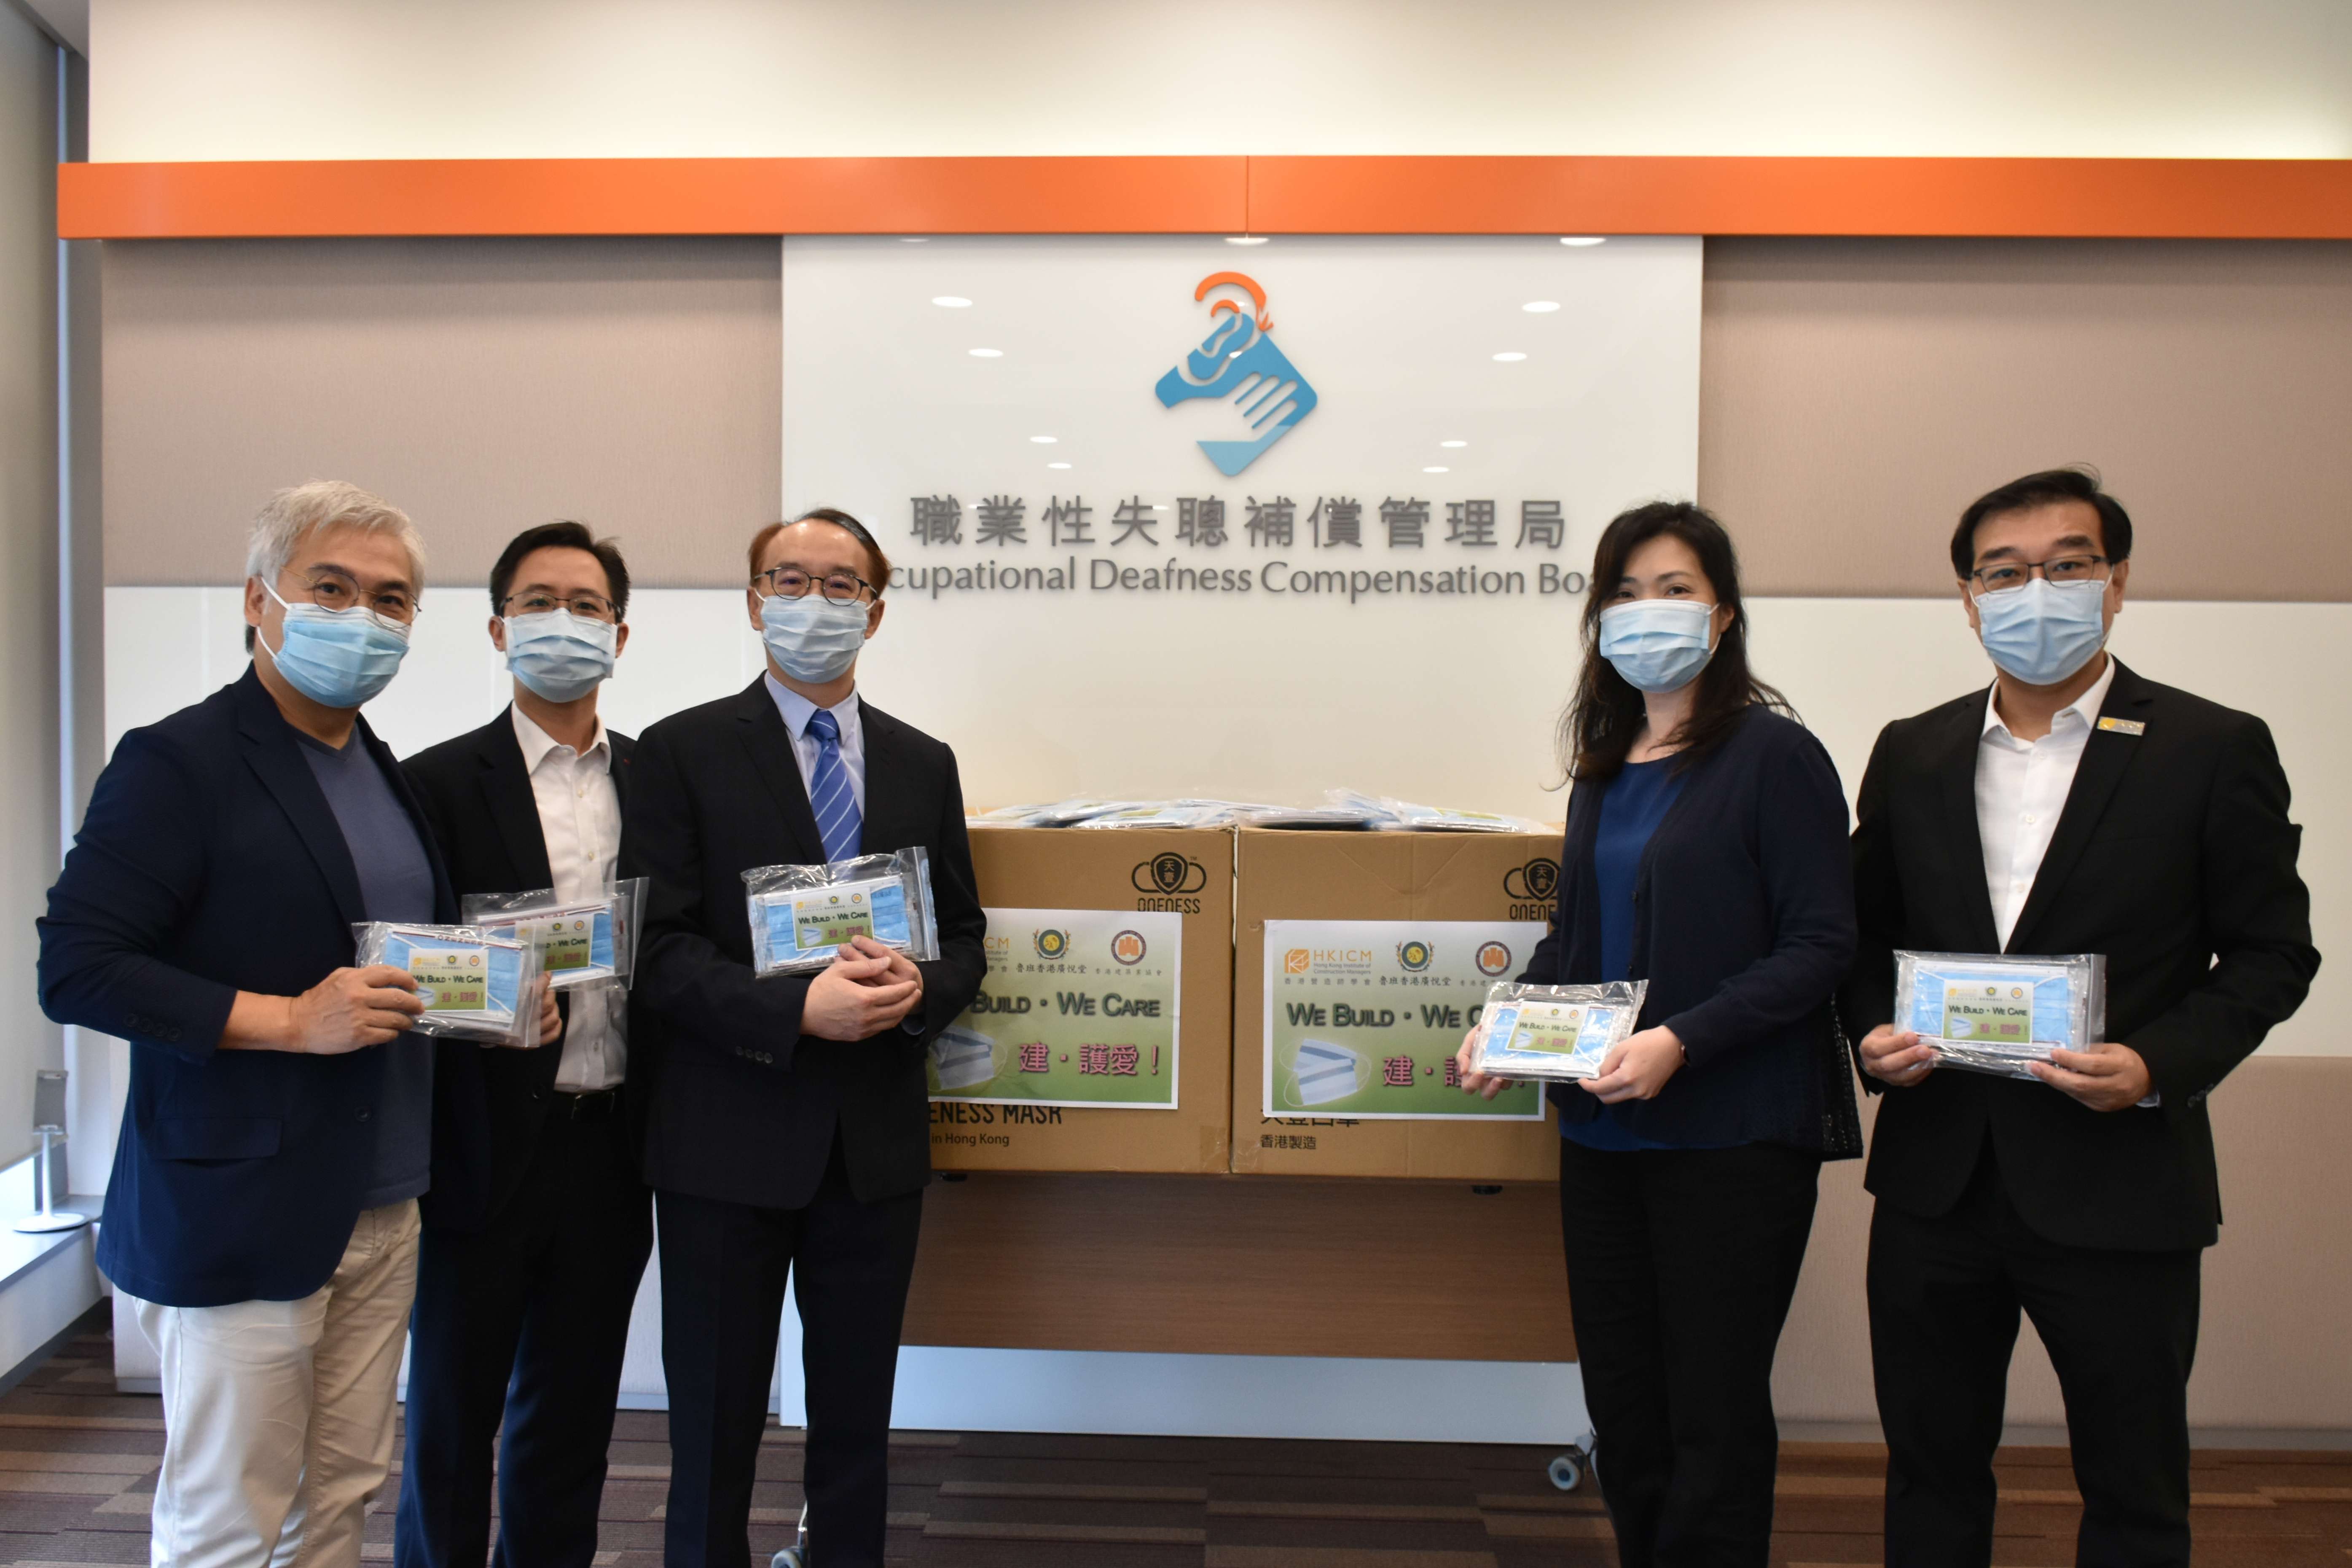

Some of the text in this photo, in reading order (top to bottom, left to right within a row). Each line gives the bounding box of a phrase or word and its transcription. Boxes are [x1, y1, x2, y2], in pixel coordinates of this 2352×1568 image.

[909, 494, 1565, 549] 職業性失聰補償管理局
[889, 556, 1075, 600] cupational
[1090, 557, 1252, 591] Deafness
[1261, 561, 1525, 604] Compensation
[1313, 950, 1372, 962] HKICM
[929, 1101, 995, 1124] ENESS
[932, 1133, 1010, 1147] in Hong Kong
[1260, 1134, 1317, 1150] 香港製造
